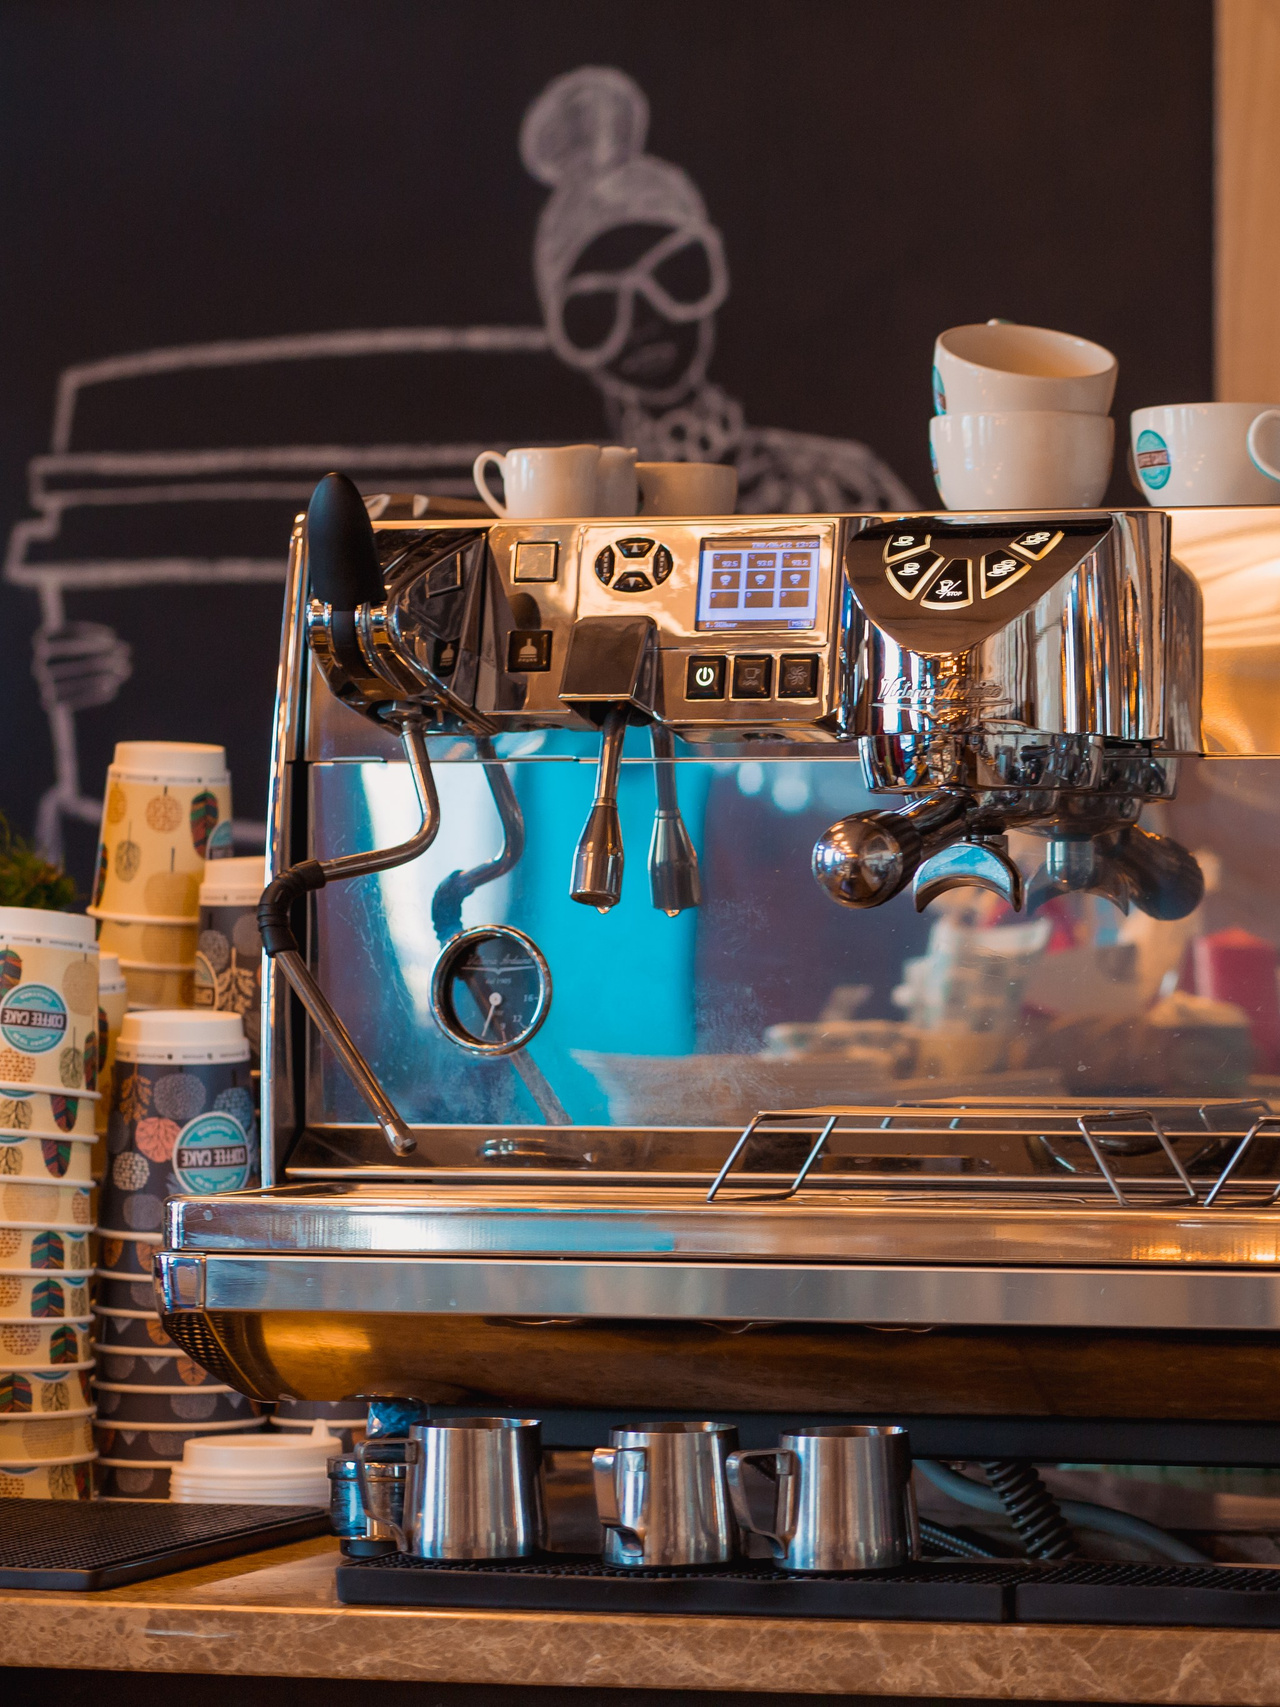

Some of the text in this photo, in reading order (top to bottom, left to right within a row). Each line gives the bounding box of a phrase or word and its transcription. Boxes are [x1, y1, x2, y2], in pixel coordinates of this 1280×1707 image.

[4, 1011, 64, 1028] COFFEE CAKE
[513, 1015, 522, 1023] 12
[181, 1147, 246, 1166] COFFEE CAKE
